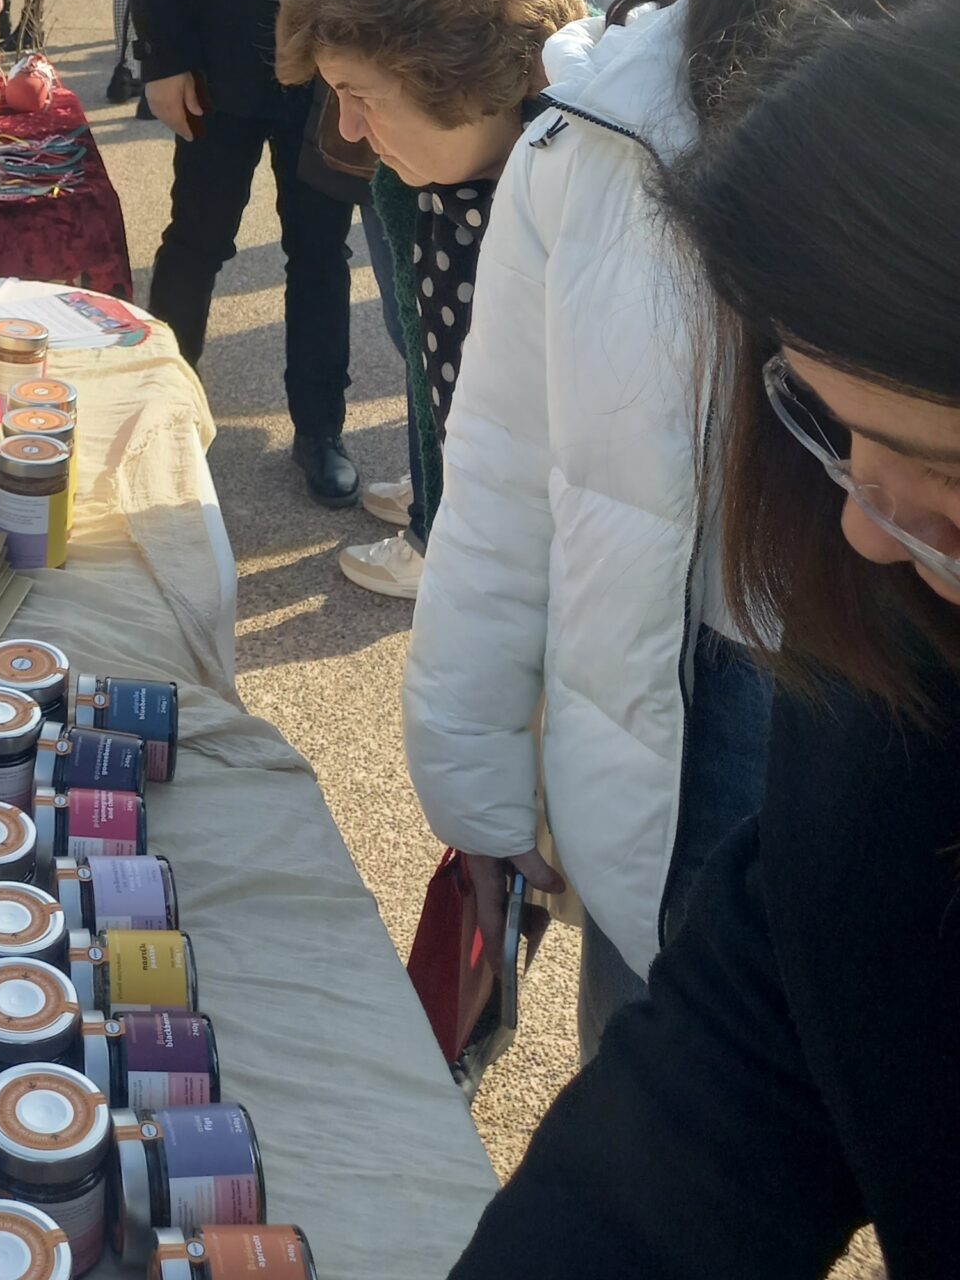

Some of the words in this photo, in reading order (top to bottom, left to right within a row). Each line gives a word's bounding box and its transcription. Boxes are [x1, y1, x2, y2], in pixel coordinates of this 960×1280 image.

[139, 943, 148, 971] παστέλι
[203, 1116, 214, 1131] figs
[232, 1116, 243, 1133] 240g
[253, 1235, 266, 1268] apricots
[287, 1243, 297, 1263] 240g
